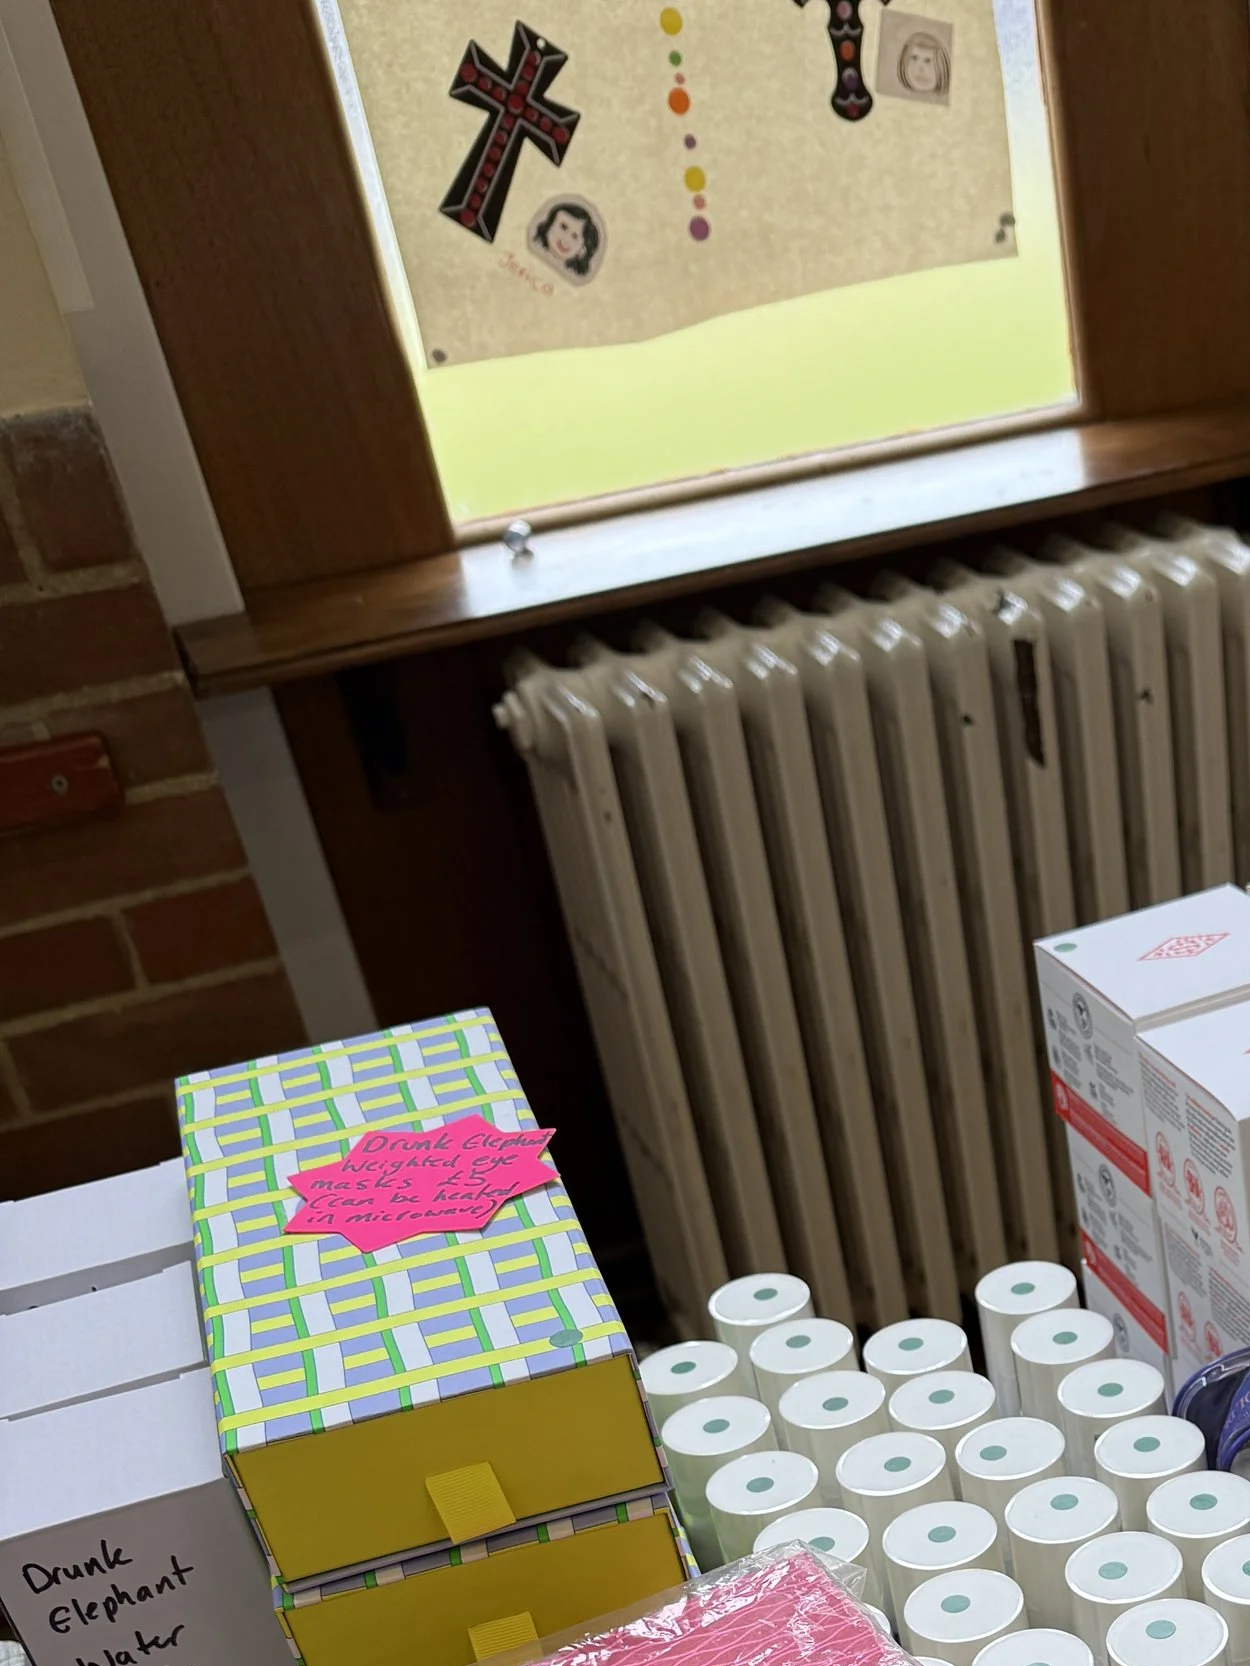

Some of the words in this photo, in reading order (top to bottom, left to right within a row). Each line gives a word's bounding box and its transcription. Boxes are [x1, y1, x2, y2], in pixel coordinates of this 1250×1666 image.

[362, 1132, 453, 1154] Drunk
[462, 1132, 554, 1151] Elephant
[471, 1153, 520, 1176] eye
[310, 1173, 413, 1191] masks
[436, 1171, 487, 1188] £5
[309, 1194, 375, 1210] (can
[390, 1192, 420, 1204] be
[432, 1182, 520, 1203] heated
[306, 1211, 335, 1225] in
[22, 1539, 133, 1594] Drunk
[49, 1555, 195, 1634] Elephant
